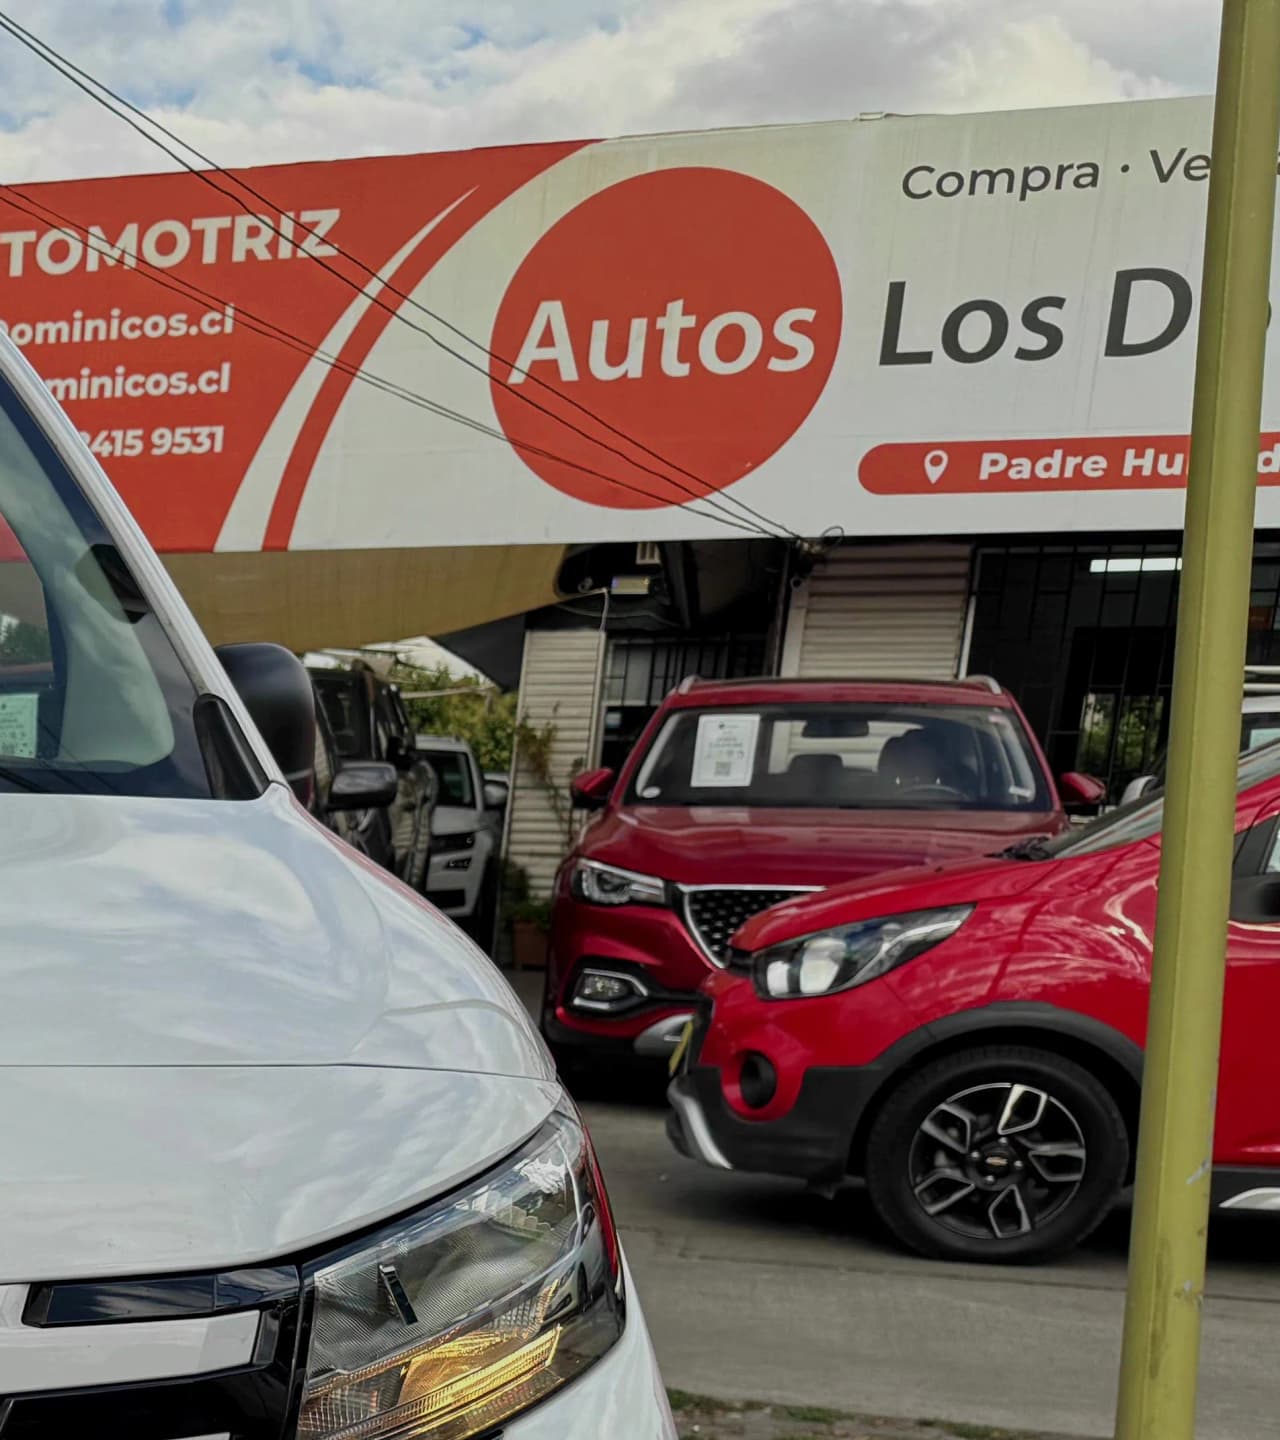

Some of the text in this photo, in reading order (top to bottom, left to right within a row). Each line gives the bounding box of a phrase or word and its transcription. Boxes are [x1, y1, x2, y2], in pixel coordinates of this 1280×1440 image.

[902, 147, 1212, 201] Compra Ve
[507, 299, 817, 384] Autos
[878, 281, 1067, 366] Los
[150, 425, 225, 456] 9531
[979, 449, 1108, 480] Padre
